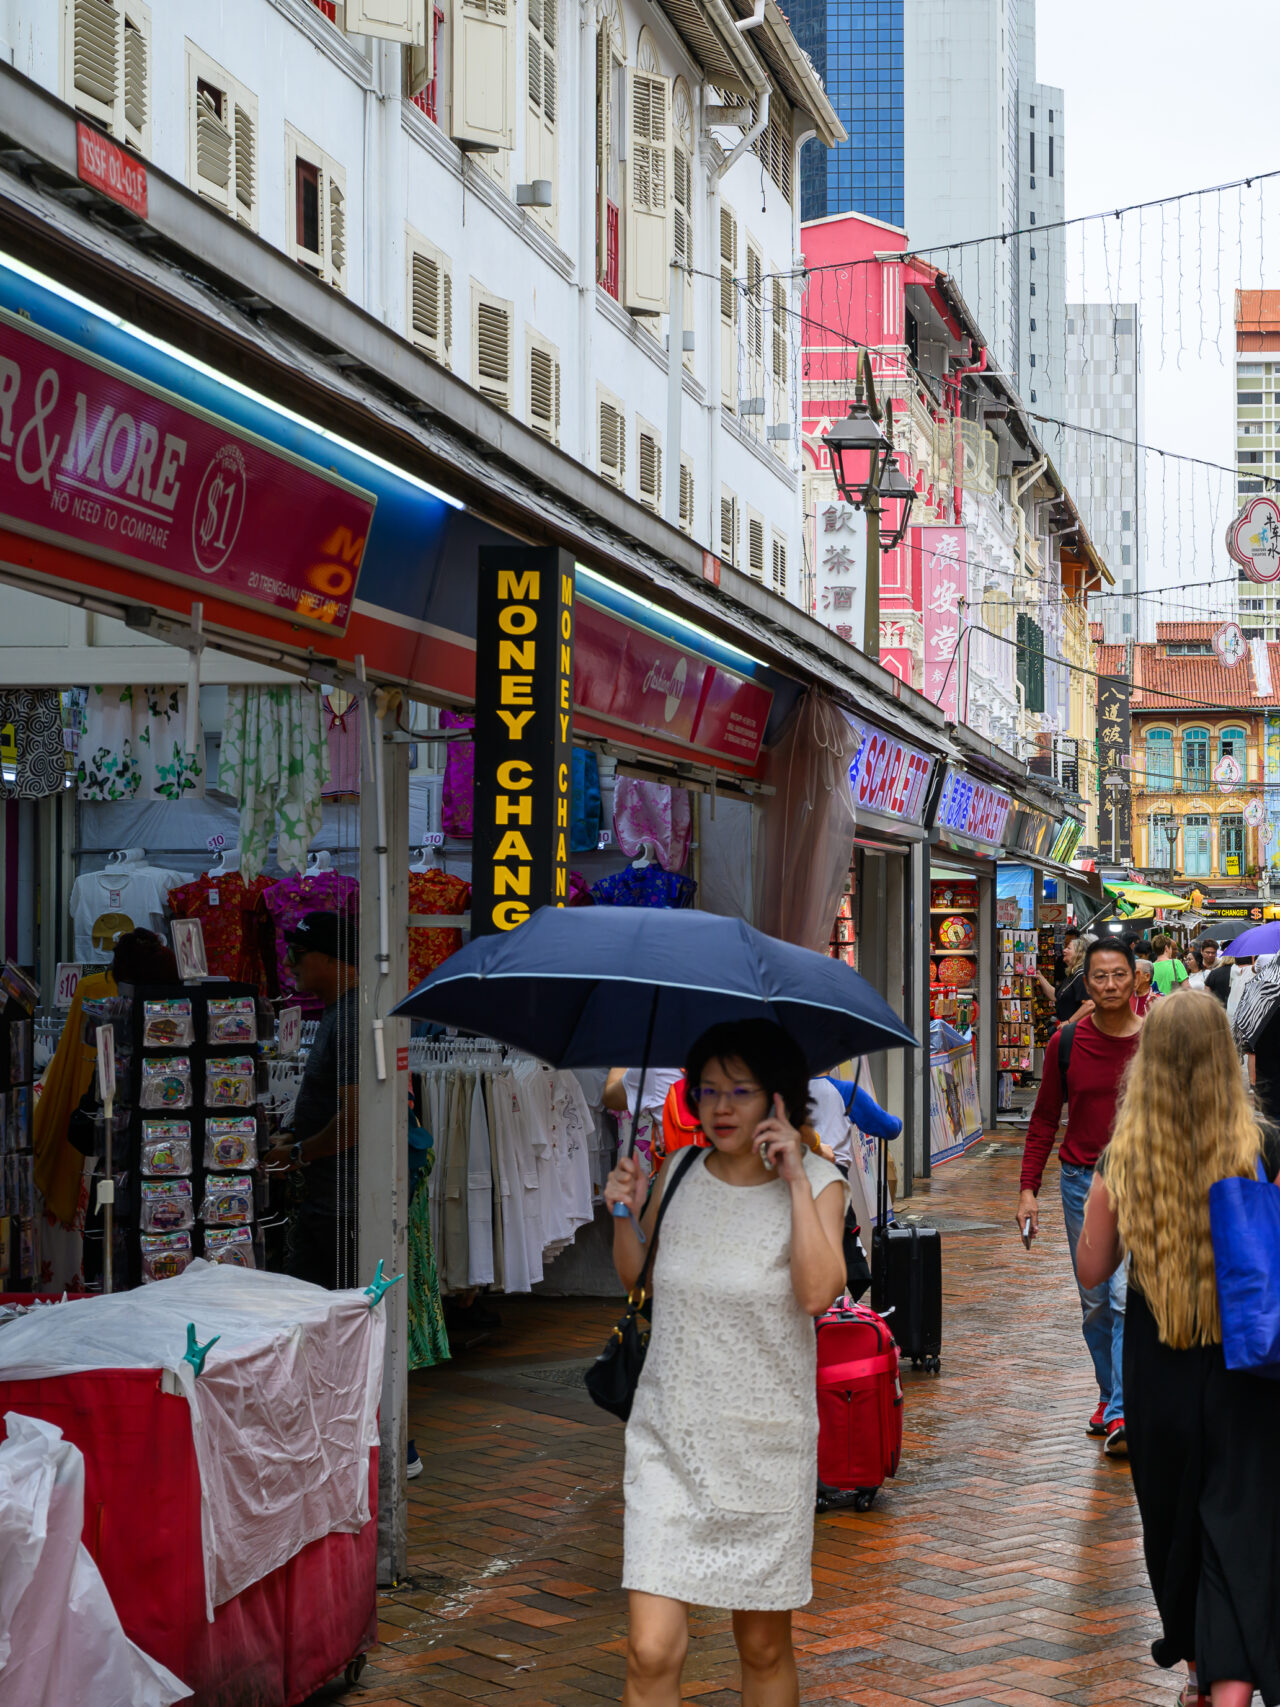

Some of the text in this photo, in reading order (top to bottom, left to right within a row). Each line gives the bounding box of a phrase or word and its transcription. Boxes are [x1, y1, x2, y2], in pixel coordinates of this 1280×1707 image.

[61, 391, 188, 511] MORE
[50, 489, 171, 549] NO NEED TO COMPARE
[199, 472, 236, 550] $1
[928, 534, 965, 662] 廣安堂
[495, 570, 541, 740] MONEY
[556, 574, 573, 908] MONEY CHAN
[859, 734, 930, 818] SCARLETT
[207, 834, 224, 847] $10
[425, 834, 441, 844] $10
[967, 784, 1010, 842] SCARLETT
[1221, 909, 1248, 917] CHANGER
